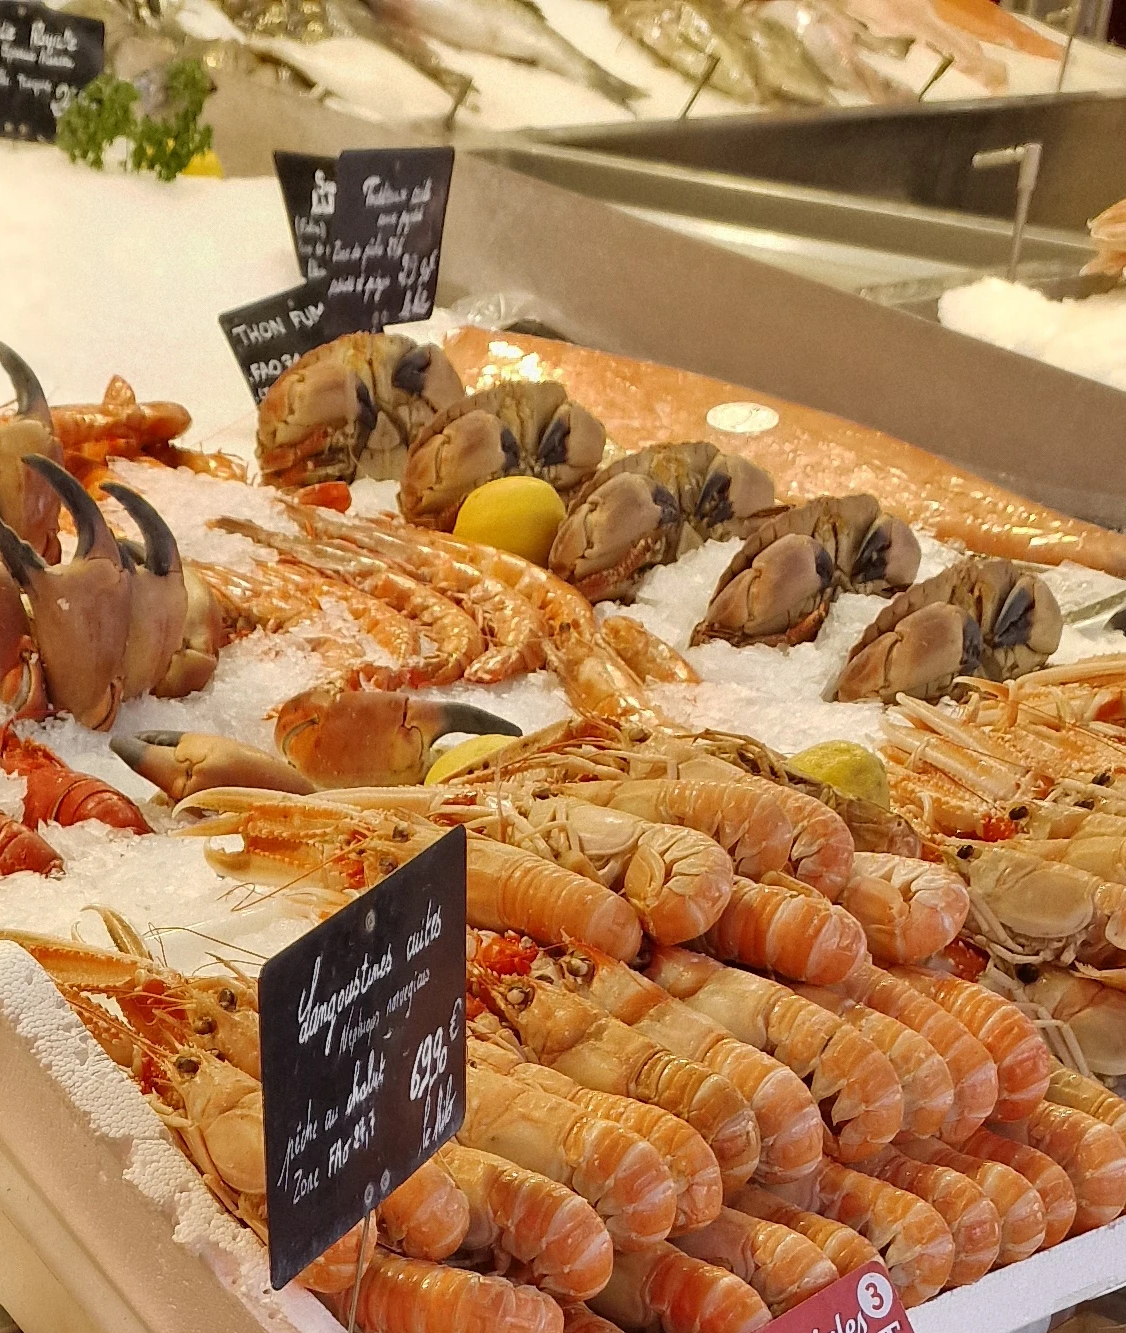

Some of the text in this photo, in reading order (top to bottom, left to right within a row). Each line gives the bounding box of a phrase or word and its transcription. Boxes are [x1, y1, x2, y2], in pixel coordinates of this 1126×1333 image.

[231, 316, 287, 347] THON
[297, 942, 392, 1058] Langoustines
[406, 899, 442, 963] cuites
[324, 1106, 339, 1131] au
[865, 1281, 885, 1310] 3
